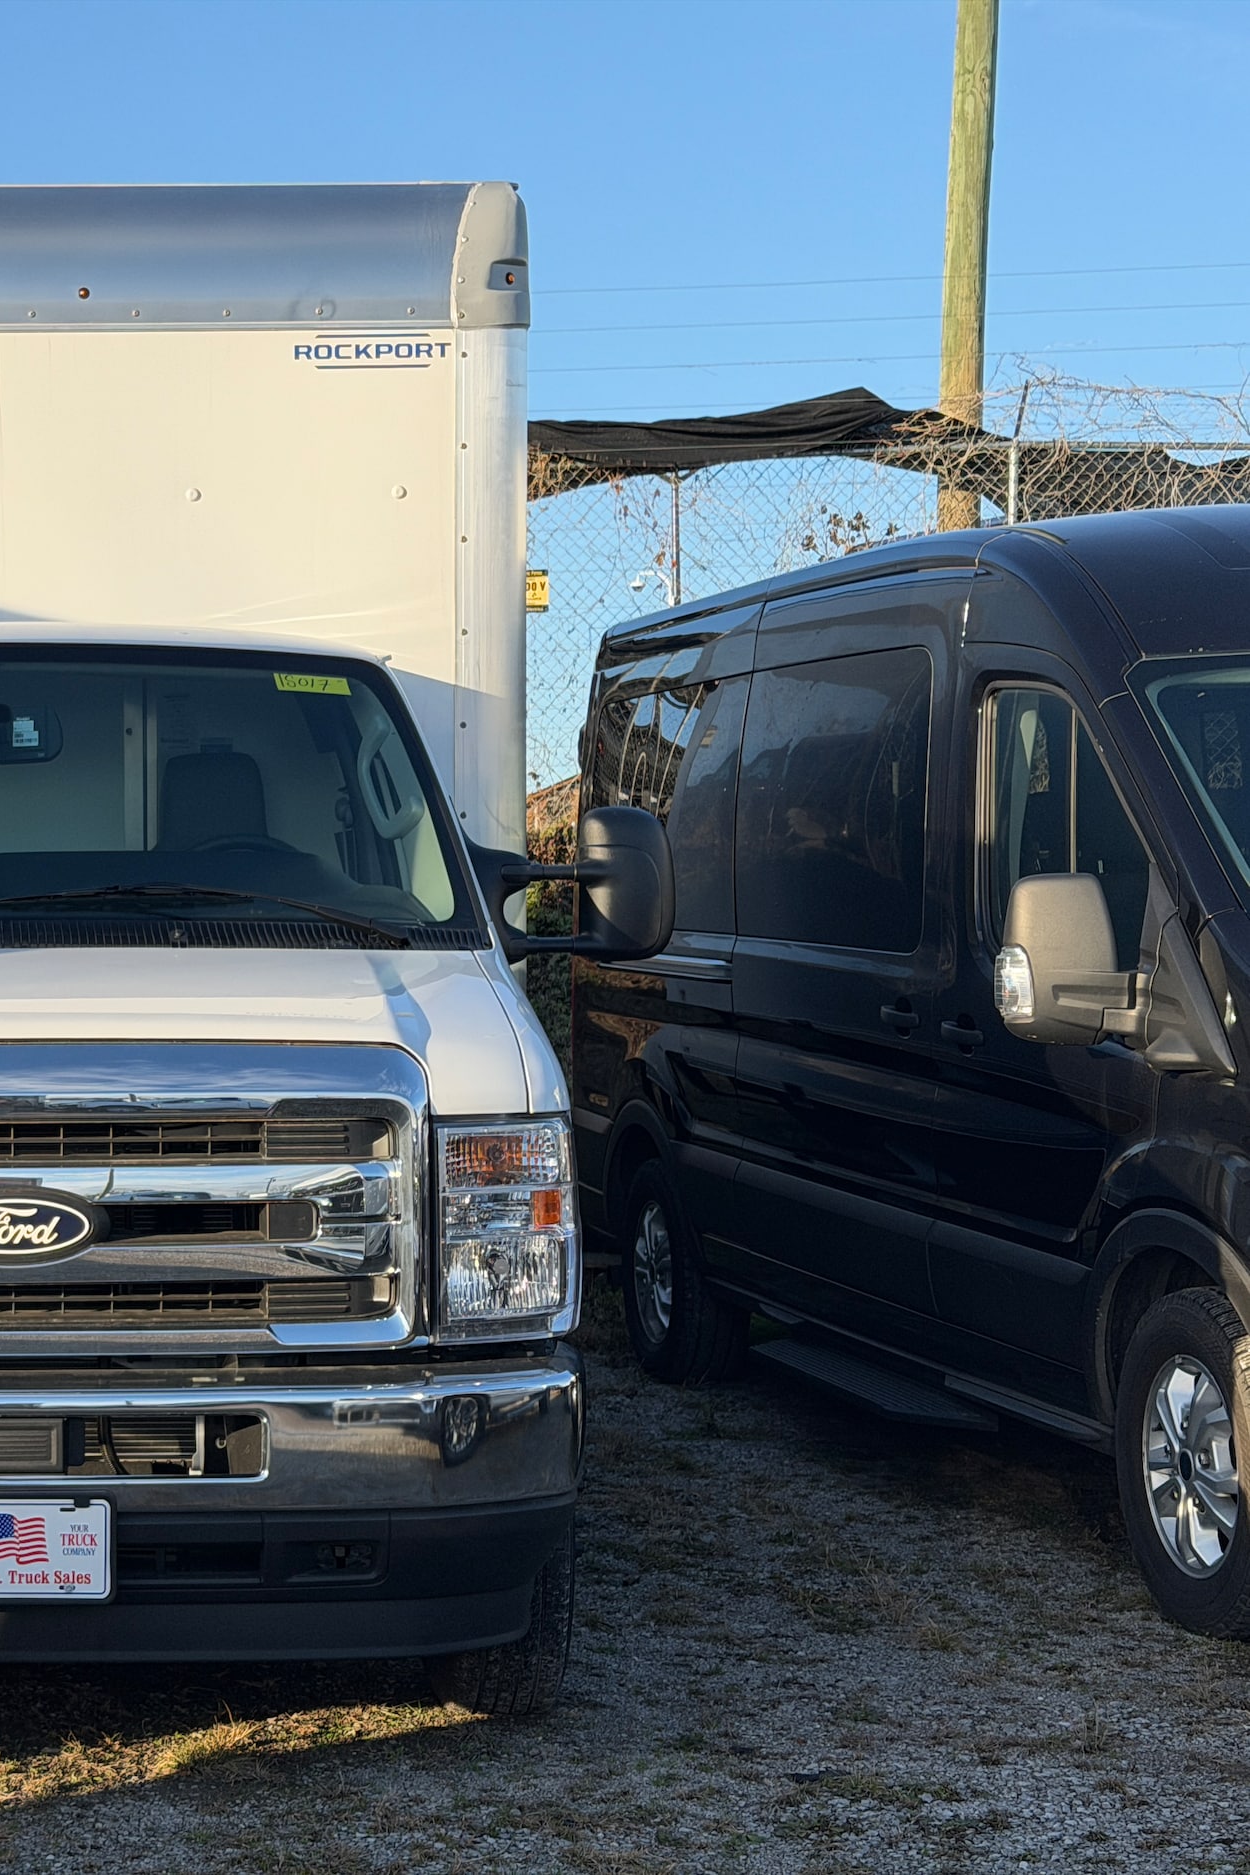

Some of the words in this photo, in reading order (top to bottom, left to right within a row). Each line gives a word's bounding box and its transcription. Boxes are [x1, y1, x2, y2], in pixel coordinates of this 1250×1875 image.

[294, 342, 452, 360] ROCKPORT
[70, 1525, 89, 1533] YOUR
[60, 1534, 98, 1546] TRUCK
[62, 1548, 96, 1556] COMPANY
[8, 1570, 50, 1584] Truck
[54, 1570, 91, 1584] Sales
